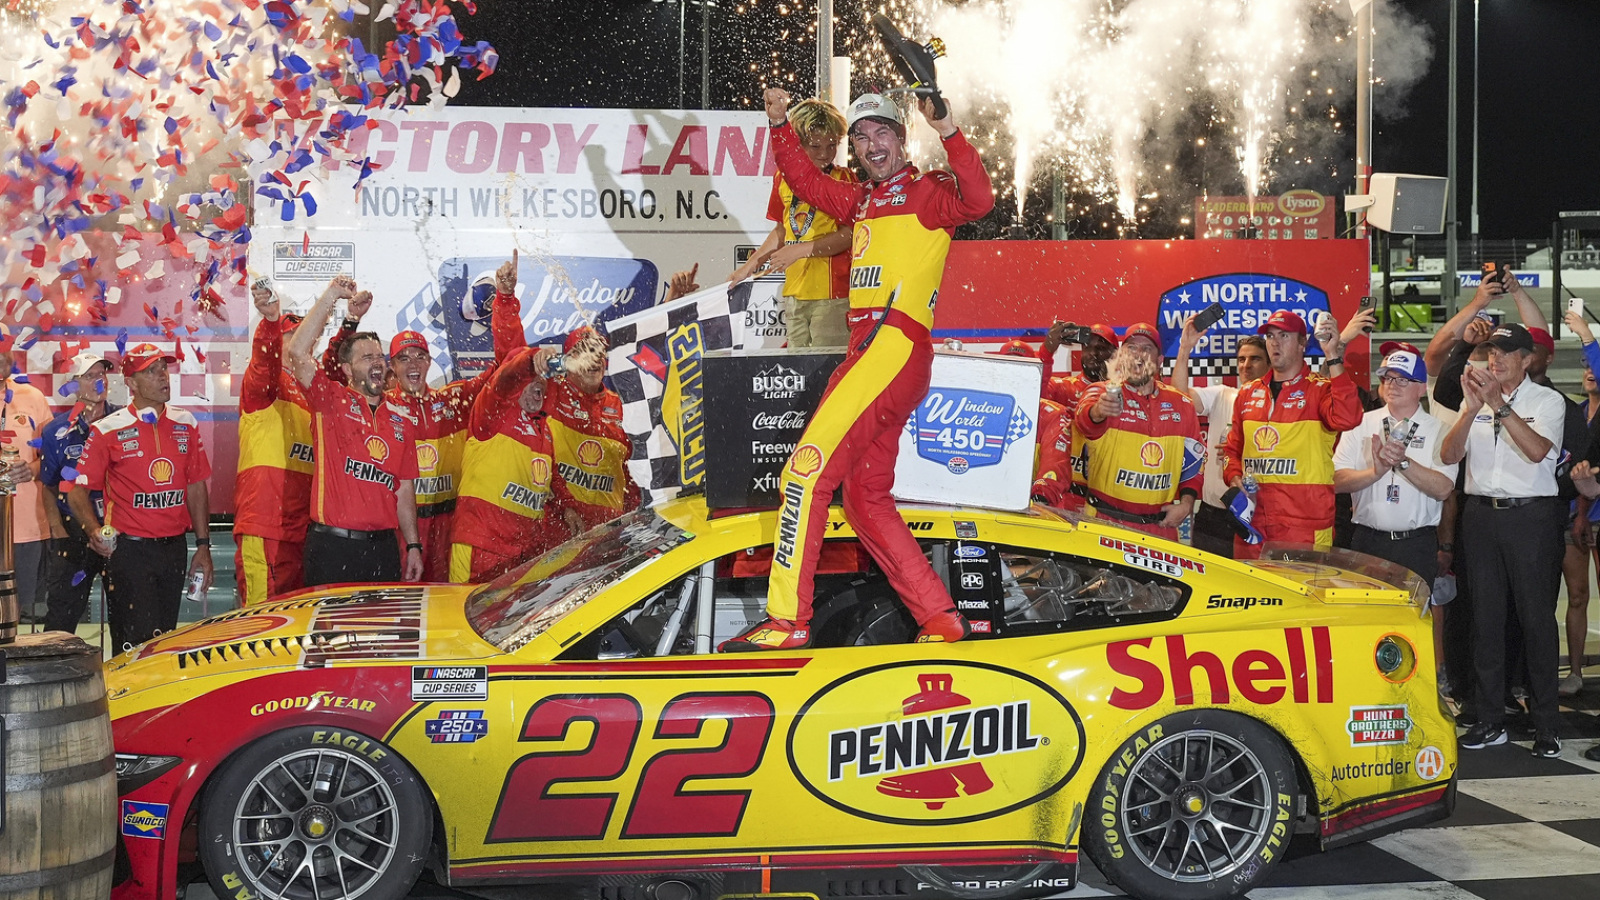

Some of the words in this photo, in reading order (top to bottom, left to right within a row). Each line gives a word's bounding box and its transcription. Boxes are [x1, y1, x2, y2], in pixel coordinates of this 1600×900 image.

[621, 124, 777, 177] LAN
[361, 186, 458, 217] NORTH
[676, 189, 729, 220] N.C.
[1285, 195, 1321, 211] Tyson
[1304, 217, 1319, 225] LAP
[285, 262, 306, 272] CUP
[307, 262, 343, 272] SERIES
[1202, 283, 1287, 303] NORTH
[745, 309, 787, 327] BUSC
[752, 375, 806, 393] BUSCH
[763, 391, 795, 399] LIGHT
[924, 392, 1004, 425] Window
[752, 410, 808, 431] Coca-Cola
[752, 441, 797, 455] Freew
[936, 427, 985, 451] 450
[557, 462, 616, 494] PENNZOIL
[1116, 469, 1173, 491] PENNZOIL
[774, 481, 806, 570] PENNZOIL
[1099, 535, 1206, 574] DISCOUNT
[1129, 553, 1177, 575] TIRE
[963, 574, 982, 587] PPG
[958, 600, 990, 610] Mazak
[1206, 594, 1284, 611] Snap-on
[792, 630, 807, 639] 22
[436, 667, 477, 679] NASCAR
[1107, 625, 1334, 710] Shell
[422, 683, 445, 693] CUP
[447, 682, 478, 693] SERIES
[1363, 709, 1395, 721] HUNT
[440, 719, 475, 734] 250
[1351, 719, 1408, 732] BROTHERS
[828, 700, 1042, 783] PENNZOIL
[1362, 729, 1396, 741] PIZZA
[311, 730, 386, 763] EAGLE
[483, 690, 776, 845] 22
[1331, 758, 1412, 782] Autotrader
[125, 815, 165, 828] SUNOCO
[1259, 792, 1292, 864] EAGLE
